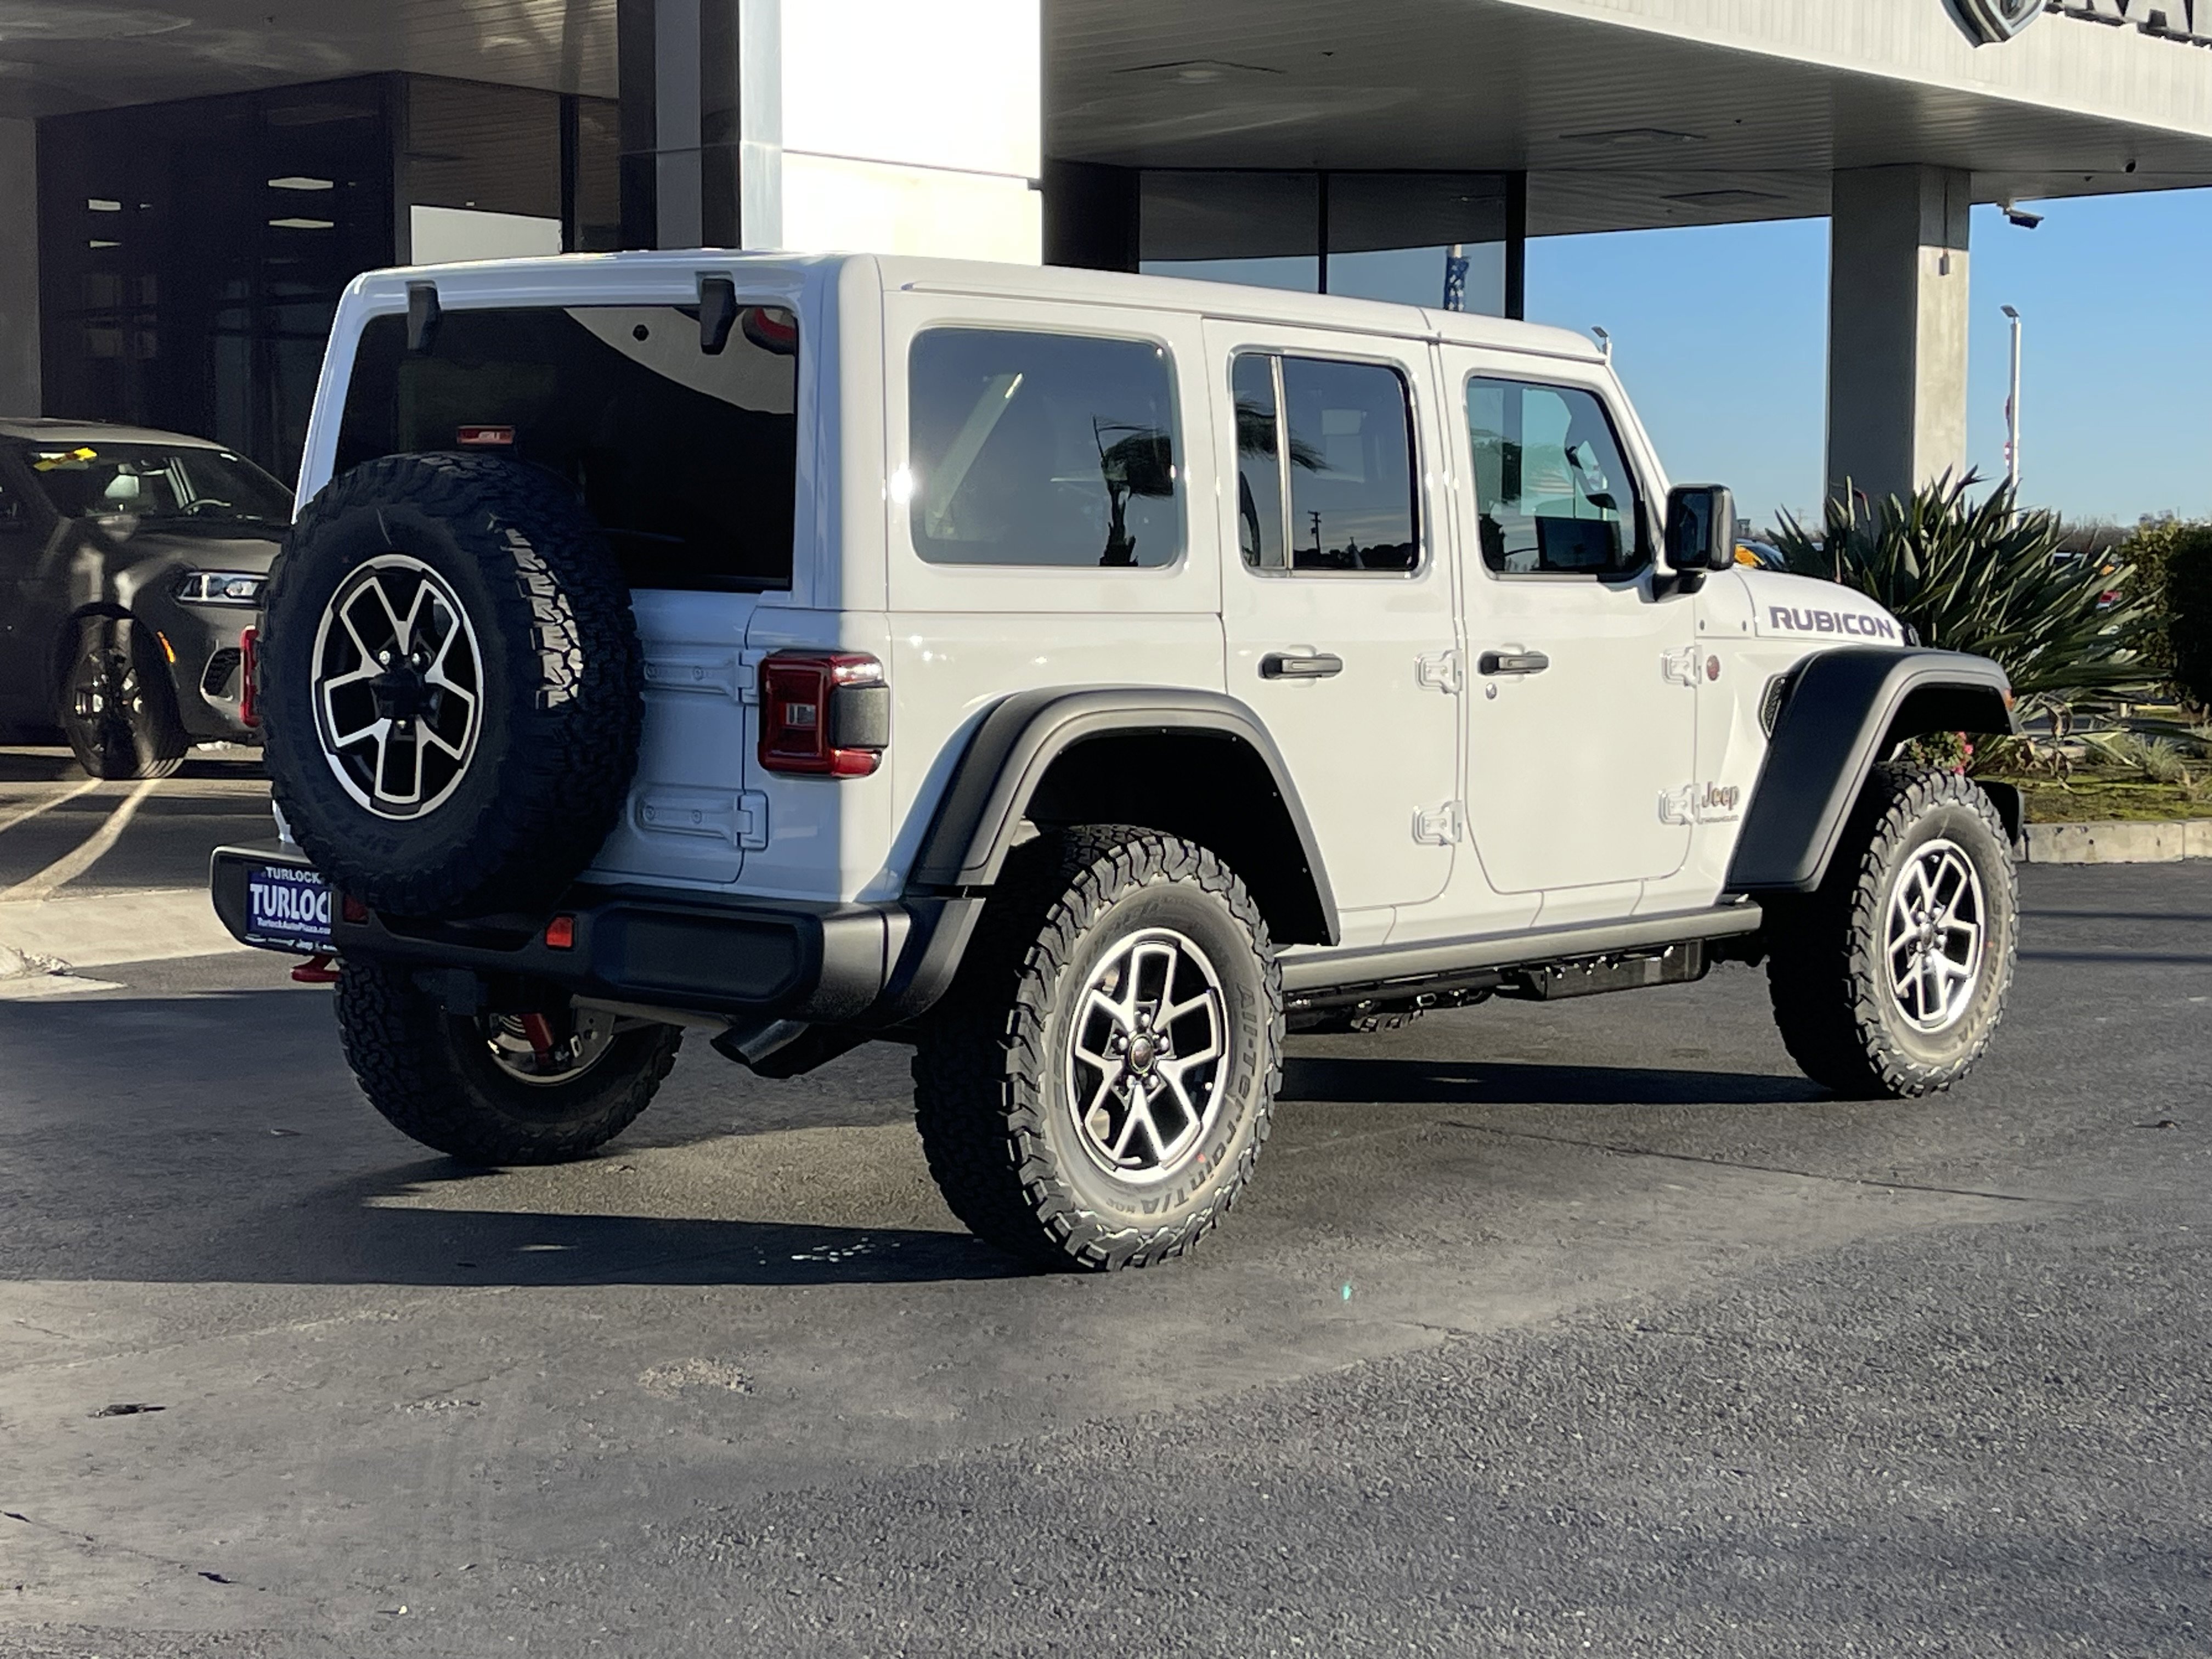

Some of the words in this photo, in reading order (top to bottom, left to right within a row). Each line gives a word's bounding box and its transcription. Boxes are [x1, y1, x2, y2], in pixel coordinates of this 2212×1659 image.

[1769, 606, 1895, 639] RUBICON
[1702, 781, 1740, 811] Jeep
[266, 867, 321, 884] TURLOCK
